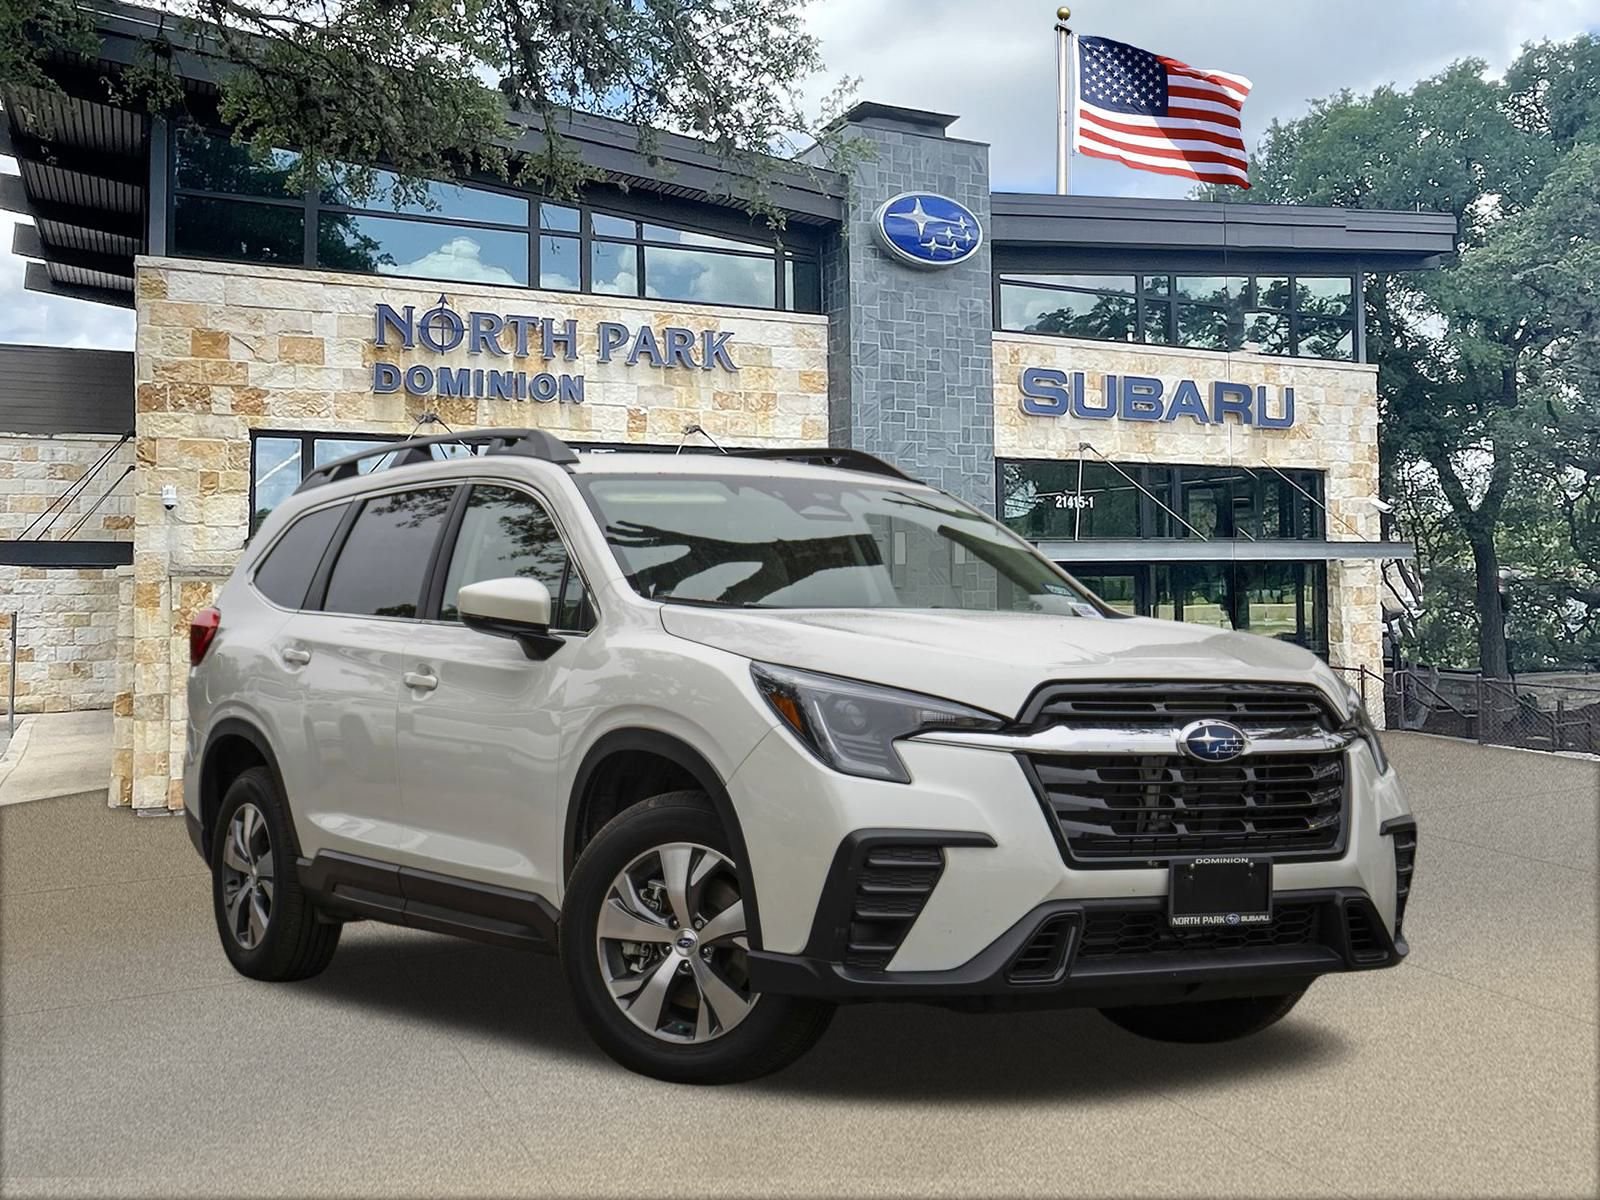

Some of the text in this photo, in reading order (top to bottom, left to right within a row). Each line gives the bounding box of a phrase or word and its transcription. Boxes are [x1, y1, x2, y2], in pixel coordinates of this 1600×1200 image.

[375, 302, 741, 372] NORTH PARK
[373, 362, 584, 403] DOMINION
[1019, 367, 1294, 429] SUBARU
[1172, 917, 1200, 925] NORTH
[1202, 916, 1225, 924] PARK
